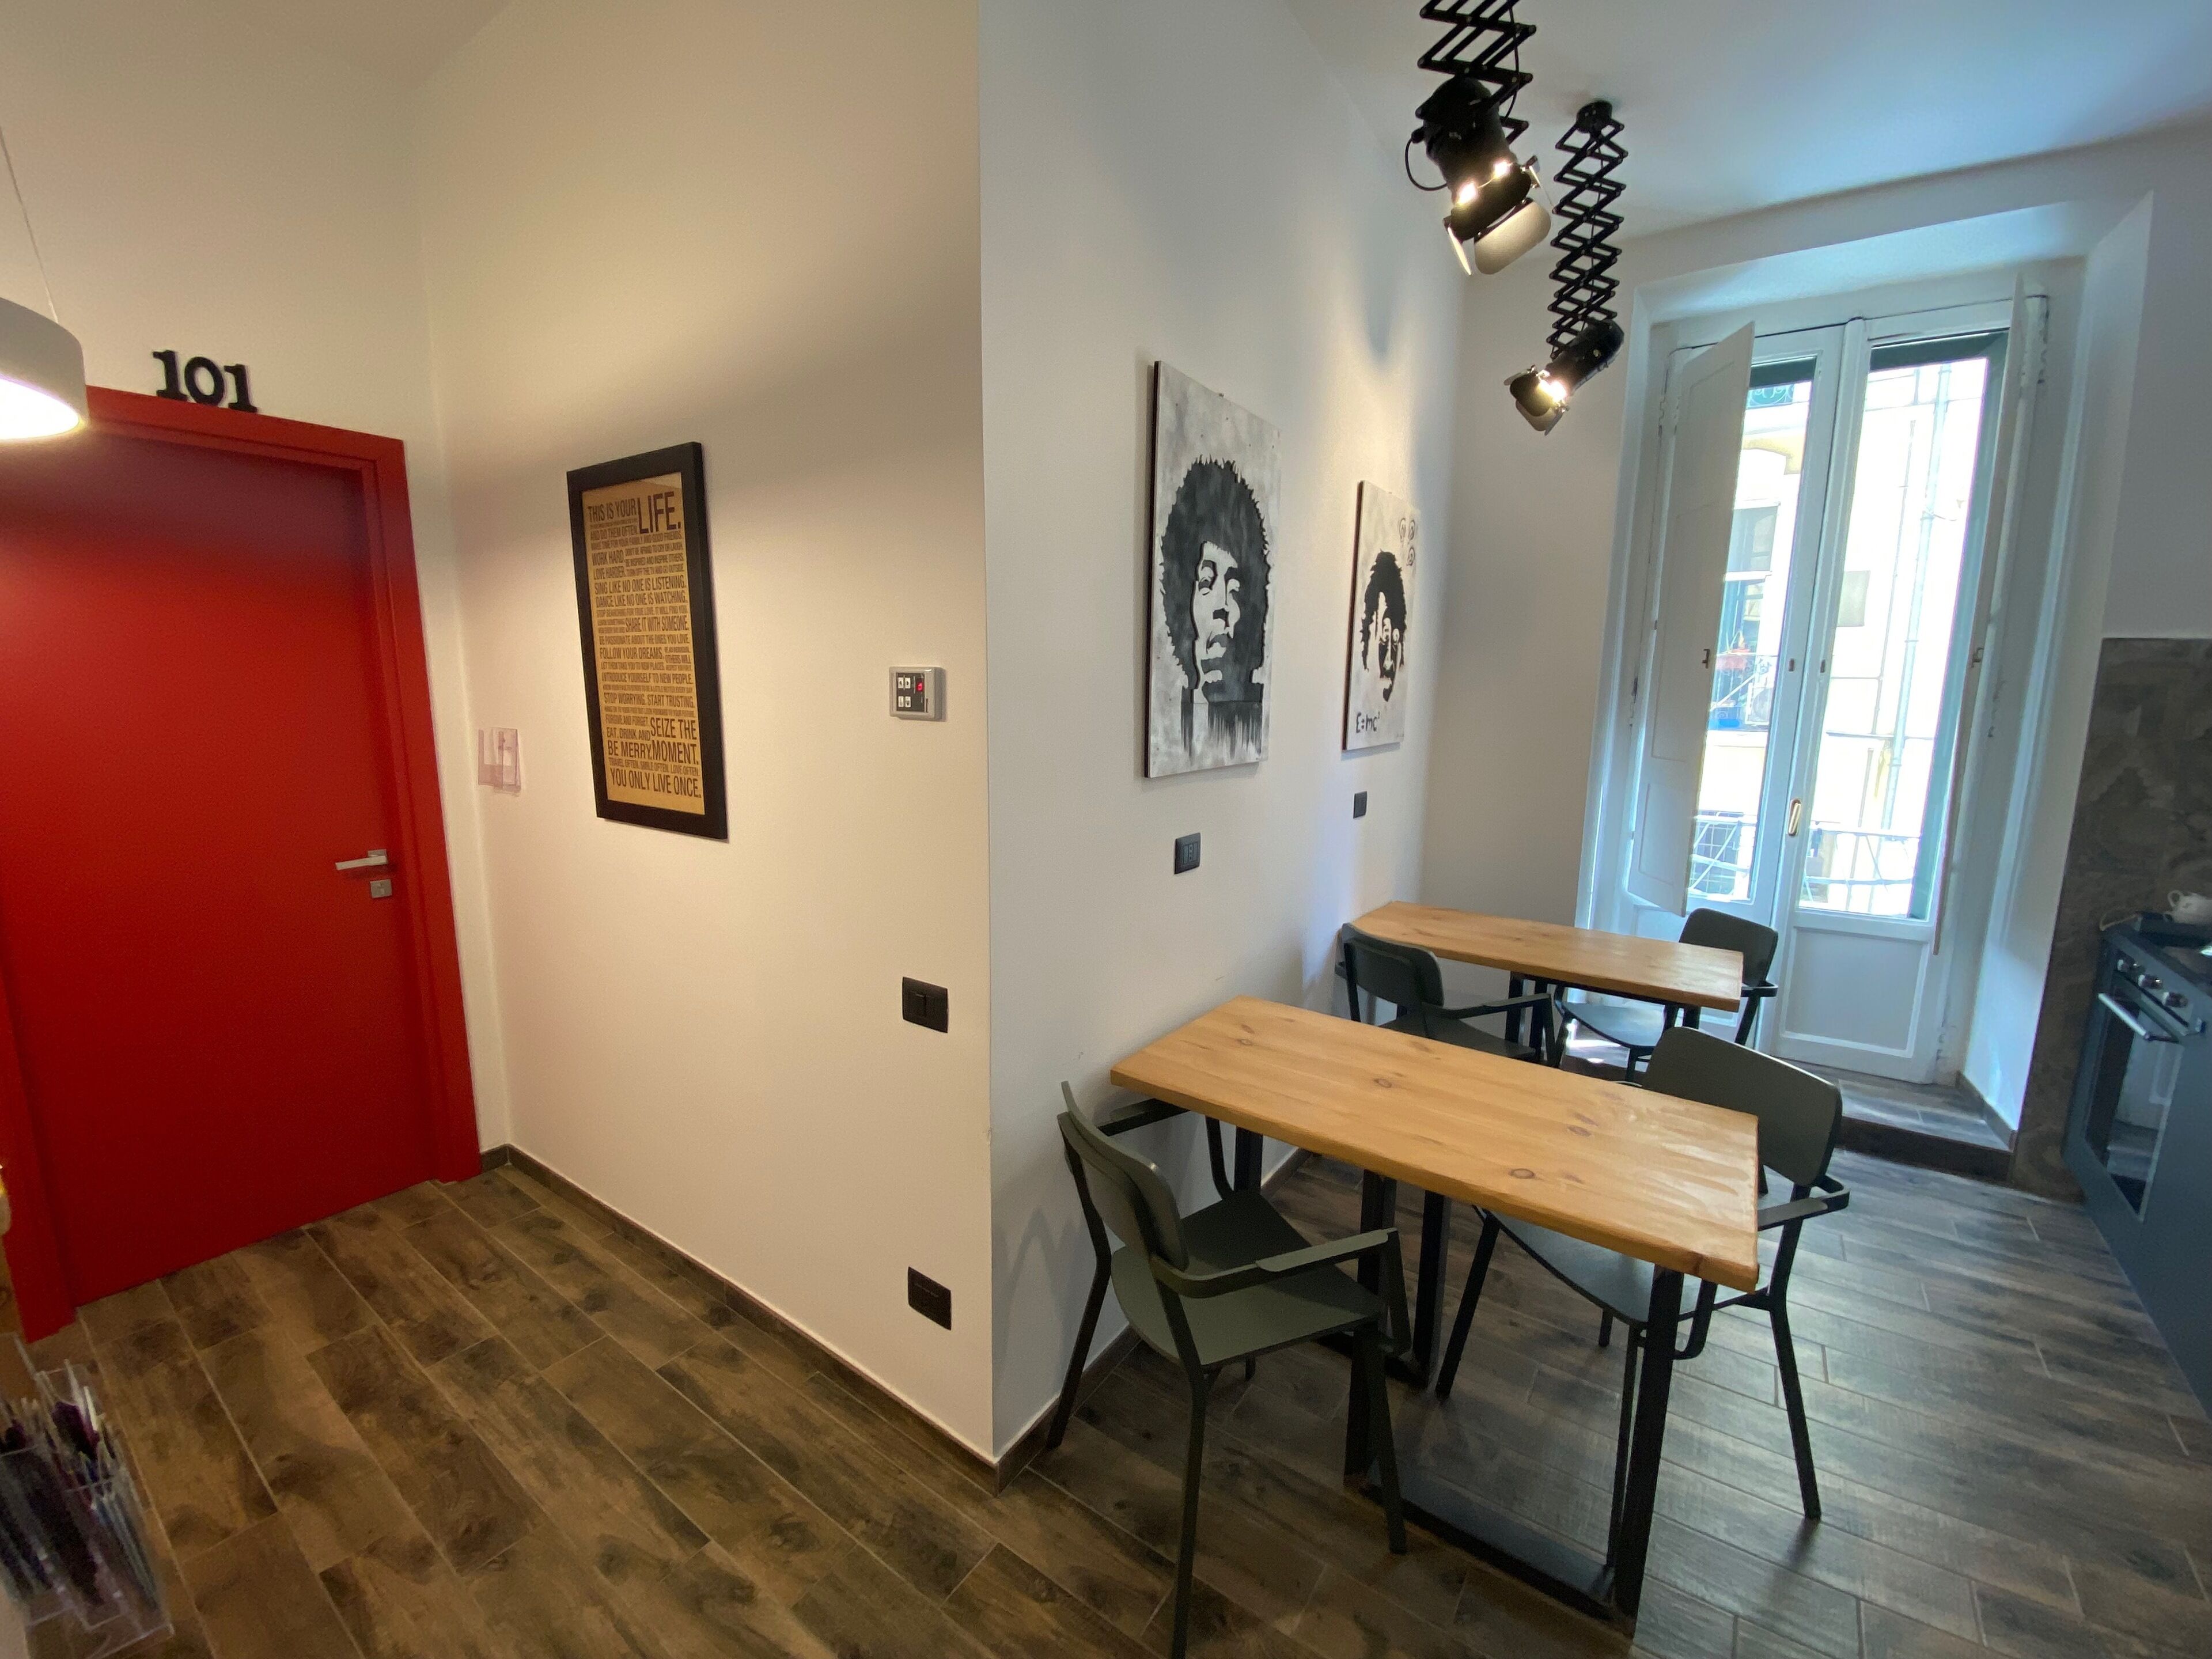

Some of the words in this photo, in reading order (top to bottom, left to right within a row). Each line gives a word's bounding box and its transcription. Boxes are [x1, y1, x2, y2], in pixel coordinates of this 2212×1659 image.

[153, 350, 257, 412] 101
[588, 503, 605, 522] THIS
[607, 503, 614, 520] IS
[615, 498, 636, 517] YOUR
[637, 491, 681, 533] LIFE.
[592, 552, 608, 566] WORK
[594, 582, 607, 594] SING
[609, 581, 622, 593] LIKE
[622, 579, 631, 592] NO
[632, 578, 644, 591] ONE
[645, 578, 652, 590] IS
[652, 575, 687, 590] LISTENING.
[596, 596, 614, 608] DANCE
[615, 594, 626, 607] LIKE
[626, 594, 634, 605] NO
[635, 593, 647, 605] ONE
[647, 593, 654, 605] IS
[641, 618, 646, 631] IT
[647, 616, 661, 631] WITH
[600, 647, 622, 659] FOLLOW
[622, 647, 637, 659] YOUR
[604, 692, 617, 703] STOP
[647, 694, 664, 706] START
[619, 728, 637, 740] DRINK
[638, 729, 651, 741] AND
[650, 717, 676, 738] SEIZE
[677, 719, 697, 740] THE
[608, 740, 619, 756] BE
[652, 740, 699, 765] MOMENT.
[610, 768, 627, 786] YOU
[628, 770, 652, 790] ONLY
[653, 772, 672, 794] LIVE
[673, 775, 702, 798] ONCE.
